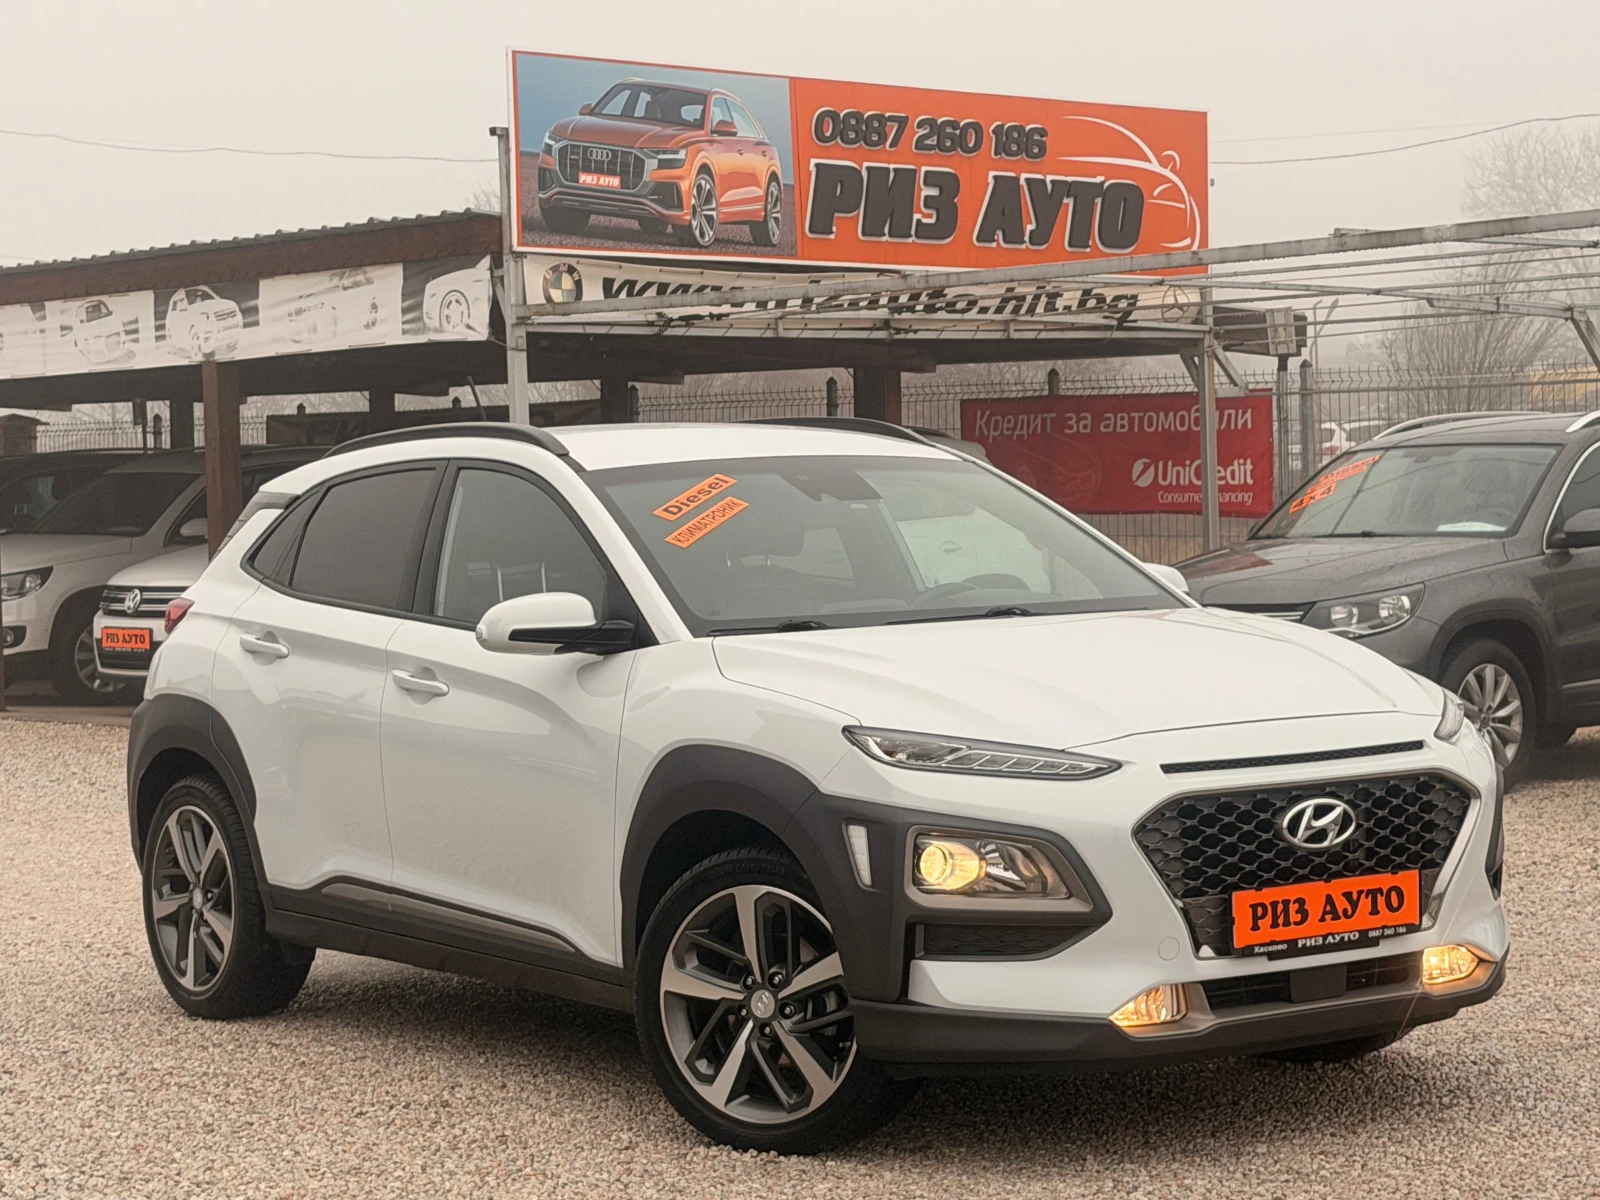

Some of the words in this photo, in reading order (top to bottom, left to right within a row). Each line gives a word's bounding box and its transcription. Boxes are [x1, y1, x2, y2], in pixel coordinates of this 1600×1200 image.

[812, 107, 909, 150] 0887
[912, 116, 984, 157] 260
[990, 121, 1049, 162] 186
[805, 158, 961, 244] РИЗ
[972, 170, 1145, 254] АУТО
[602, 276, 1140, 324] ww.auto.hit.bg
[975, 409, 1056, 443] Кредит
[1064, 411, 1092, 434] за
[1157, 458, 1254, 487] UniCedit
[662, 476, 730, 516] Diesel
[1158, 490, 1203, 504] Consume
[1217, 489, 1254, 507] ancing
[671, 499, 742, 545] КЛИМАТРОНИК
[121, 633, 146, 645] АУТО
[1249, 897, 1310, 932] РИЗ
[1317, 885, 1405, 923] АУТО
[1297, 936, 1324, 948] РИЗ
[1324, 931, 1360, 944] АУТО
